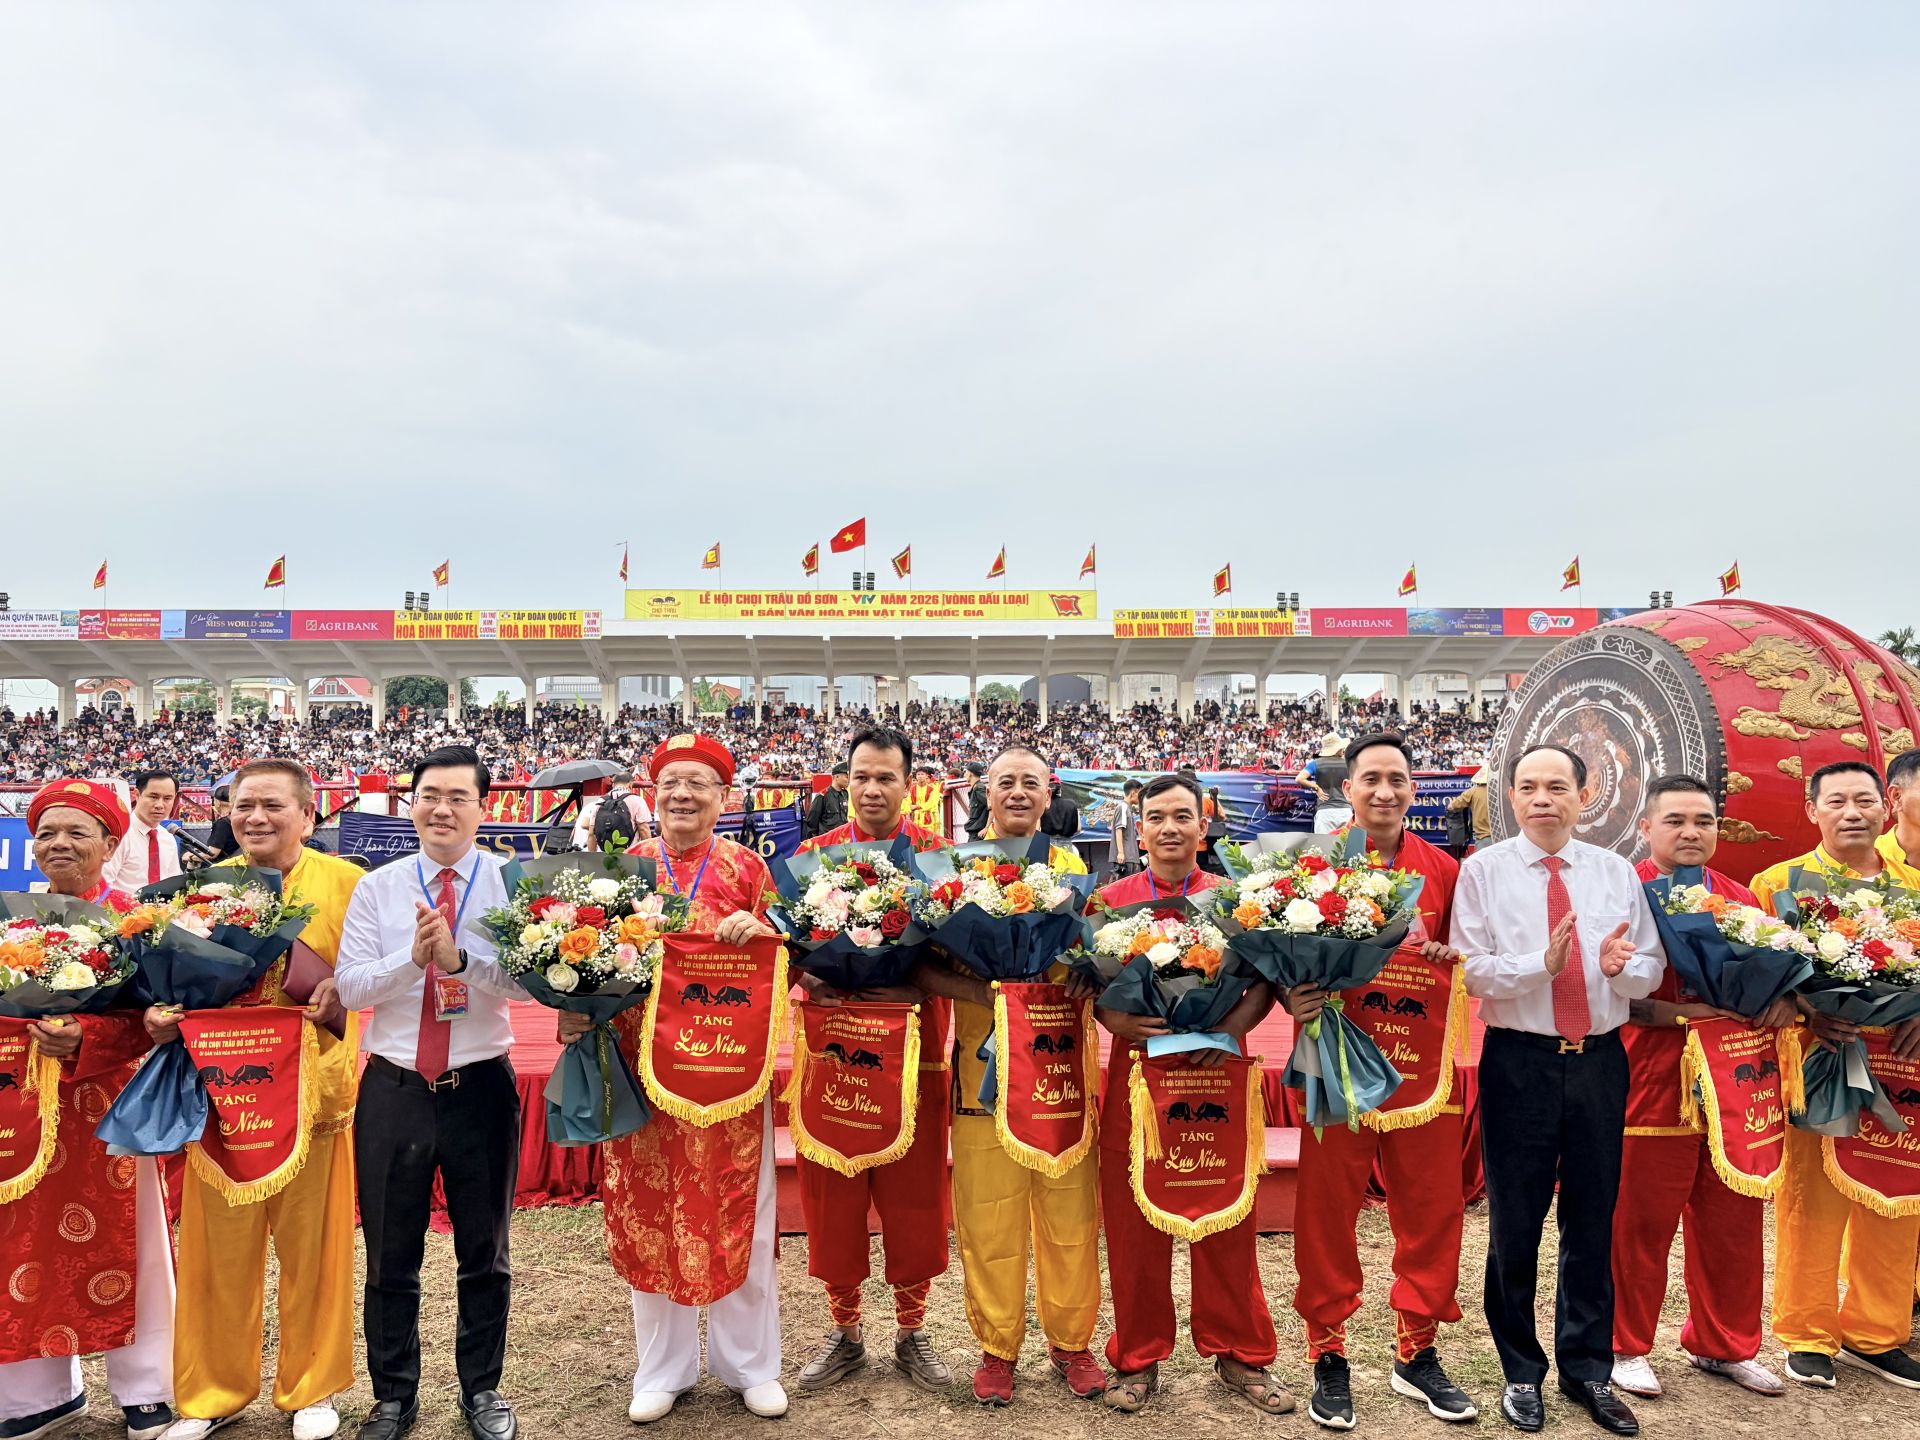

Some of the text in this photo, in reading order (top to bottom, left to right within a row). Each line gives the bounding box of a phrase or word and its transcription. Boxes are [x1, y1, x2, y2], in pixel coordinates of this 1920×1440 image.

[700, 592, 710, 604] LỄ
[714, 594, 732, 606] HỘI
[736, 594, 762, 607] CHỌI
[765, 593, 793, 604] TRÂU
[797, 592, 812, 604] ĐỒ
[814, 593, 838, 604] SƠN
[851, 594, 876, 604] VTV
[880, 593, 906, 604] NĂM
[910, 594, 939, 604] 2026
[979, 592, 1000, 604] ĐẤU
[409, 611, 472, 621] TẬP ĐOÀN QUỐC TẾ
[513, 612, 576, 621] TẬP ĐOÀN QUỐC TẾ
[758, 608, 784, 616] SẢN
[788, 608, 820, 616] VĂN
[872, 608, 895, 618] VẬT
[900, 608, 922, 616] THỂ
[926, 608, 960, 618] QUỐC
[1127, 610, 1187, 620] TẬP ĐOÀN QUỐC TẾ
[1227, 610, 1287, 620] TẬP ĐOÀN QUỐC TẾ
[319, 621, 379, 631] AGRIBANK
[1137, 620, 1159, 636] BÌNH
[1162, 623, 1194, 636] TRAVEL
[1237, 620, 1259, 636] BÌNH
[1262, 622, 1294, 635] TRAVEL
[1336, 618, 1393, 628] AGRIBANK
[1550, 617, 1570, 626] VTV
[419, 622, 442, 638] BÌNH
[445, 624, 478, 638] TRAVEL
[523, 622, 546, 638] BÌNH
[549, 624, 582, 638] TRAVEL
[1434, 780, 1454, 790] QUỐC
[692, 1015, 733, 1028] TẶNG
[1374, 1022, 1410, 1036] TẶNG
[209, 1041, 220, 1050] CHỌI
[222, 1040, 235, 1048] TRÂU
[674, 1028, 748, 1058] Lưu Niệm
[1390, 1041, 1421, 1064] Niệm
[1045, 1062, 1072, 1076] TẶNG
[836, 1073, 868, 1087] TẶNG
[1032, 1078, 1060, 1105] Lưu
[1751, 1088, 1774, 1102] TẶNG
[212, 1094, 256, 1108] TẶNG
[821, 1082, 882, 1116] Lưu Niệm
[238, 1110, 276, 1135] Niệm
[1744, 1107, 1766, 1132] Lưu
[1180, 1132, 1214, 1142] TẶNG
[1165, 1146, 1227, 1172] Lưu Niệm
